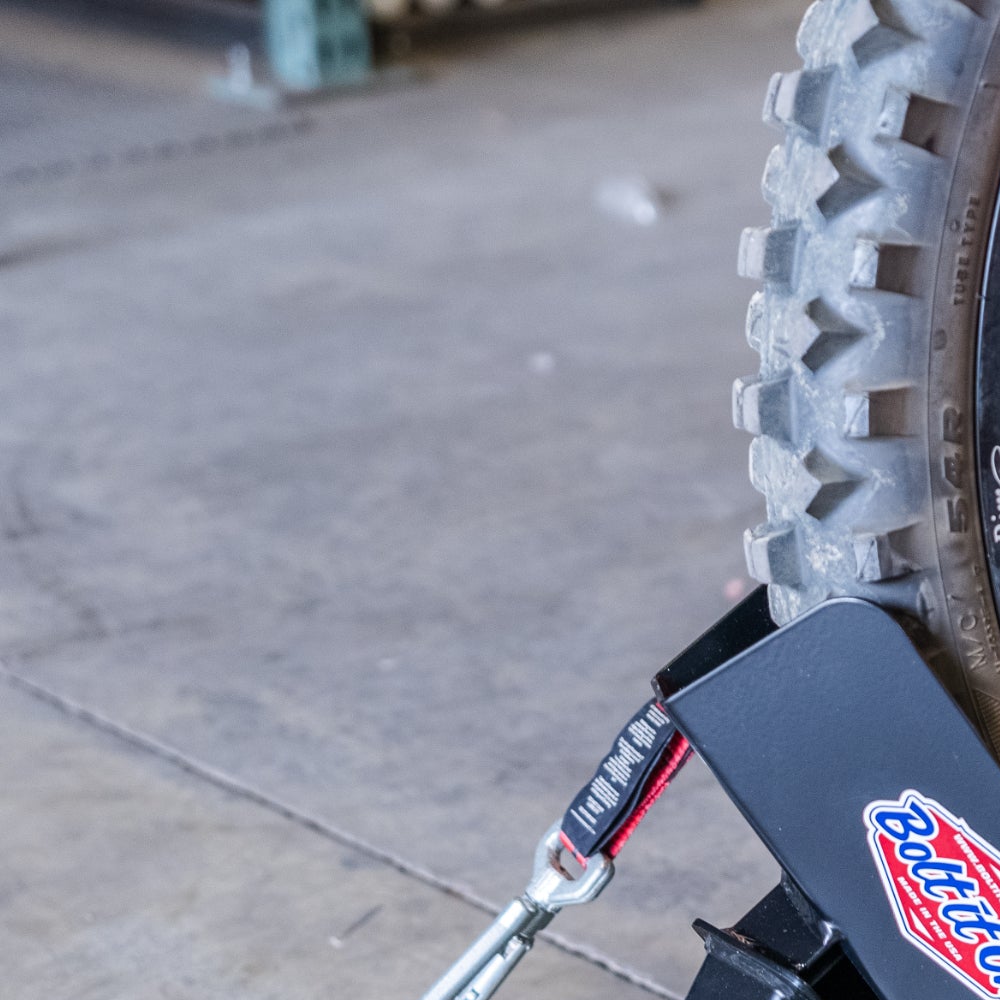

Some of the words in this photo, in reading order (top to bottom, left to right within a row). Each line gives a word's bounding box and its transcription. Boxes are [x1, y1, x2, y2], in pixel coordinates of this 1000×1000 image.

[960, 194, 982, 247] TYPE
[875, 801, 976, 901] Bolt
[897, 876, 922, 907] MADE
[919, 905, 931, 919] IN
[929, 918, 947, 941] THE
[945, 939, 963, 962] USA
